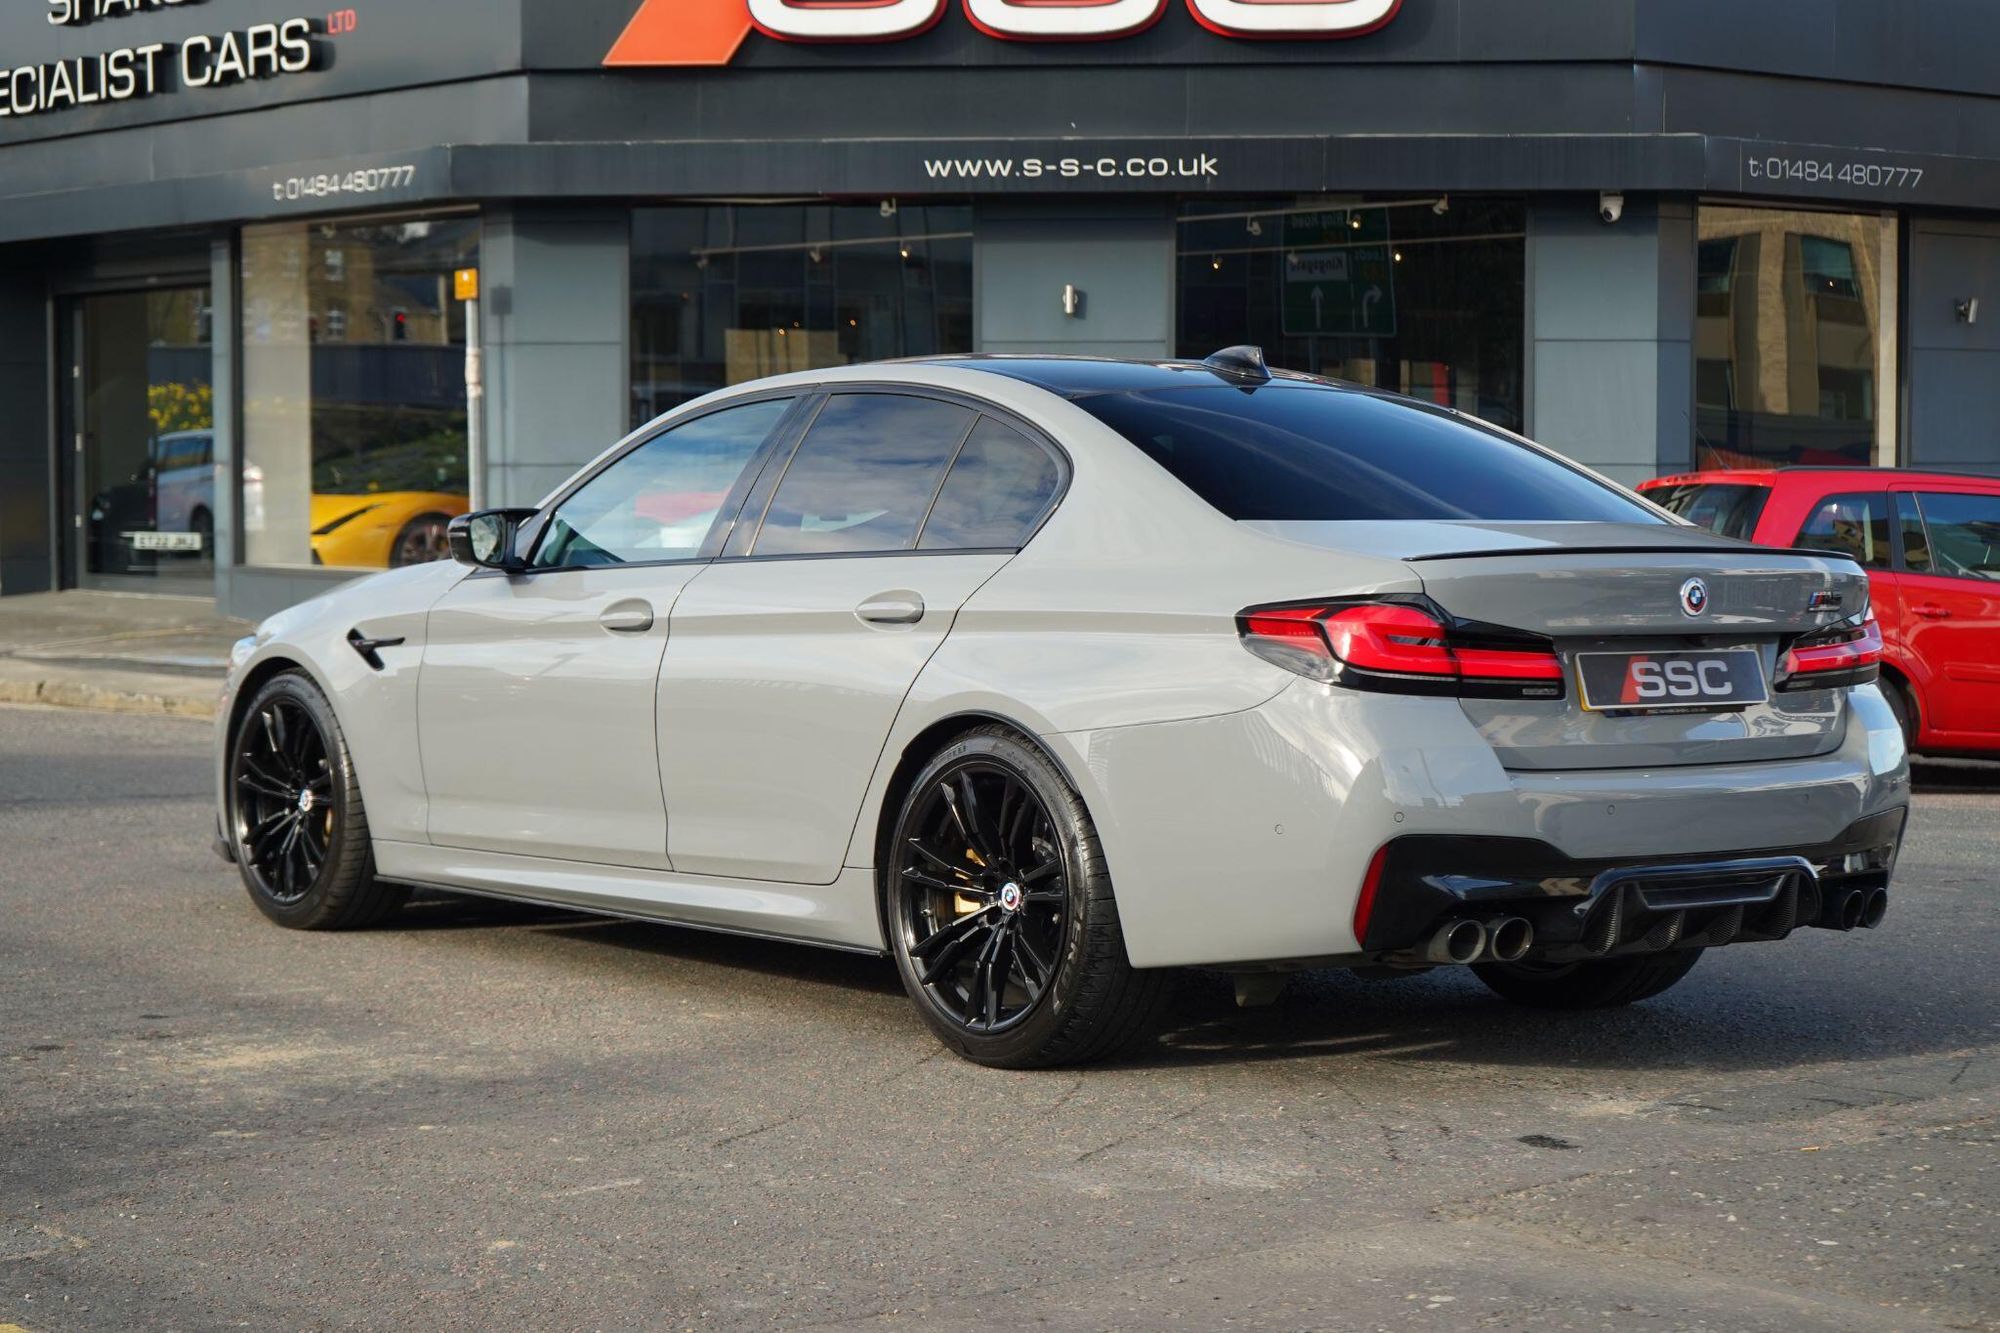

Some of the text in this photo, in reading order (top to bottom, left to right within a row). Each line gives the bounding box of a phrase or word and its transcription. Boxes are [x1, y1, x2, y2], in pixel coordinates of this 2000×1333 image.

[182, 18, 311, 88] CARS
[326, 9, 356, 35] LTD
[341, 164, 415, 193] 480777
[924, 153, 1218, 178] www.s-s-c.co.uk
[1766, 157, 1834, 182] 01484
[1837, 163, 1923, 188] 480777
[1631, 659, 1733, 697] SSC
